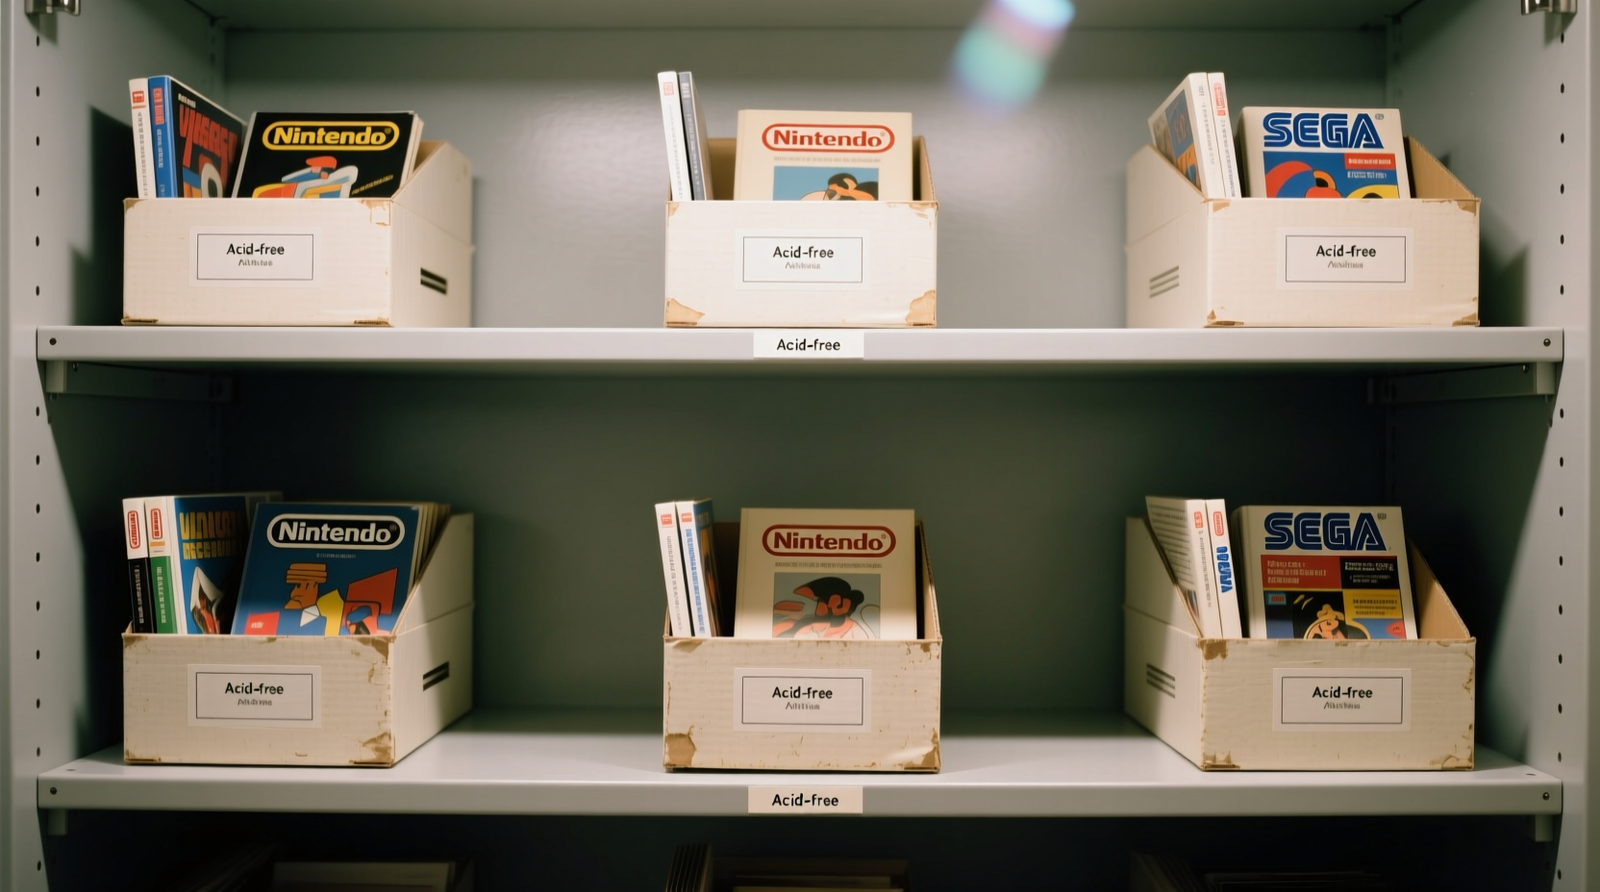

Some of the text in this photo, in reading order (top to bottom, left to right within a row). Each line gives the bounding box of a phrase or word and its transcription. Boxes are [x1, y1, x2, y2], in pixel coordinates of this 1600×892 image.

[273, 126, 387, 145] Nintendo
[1263, 113, 1384, 149] SEGA
[773, 130, 883, 147] Nintendo
[226, 243, 285, 255] Acid-free
[773, 246, 834, 259] Acid-free
[1316, 245, 1376, 257] Acid-free
[777, 339, 841, 351] Acid-free
[278, 521, 391, 543] Nintendo
[1264, 512, 1387, 551] SEGA
[774, 532, 883, 550] Nintendo
[225, 682, 284, 695] Acid-free
[772, 686, 833, 699] Acid-free
[1312, 686, 1373, 699] Acid-free
[772, 793, 839, 807] Acid-free
